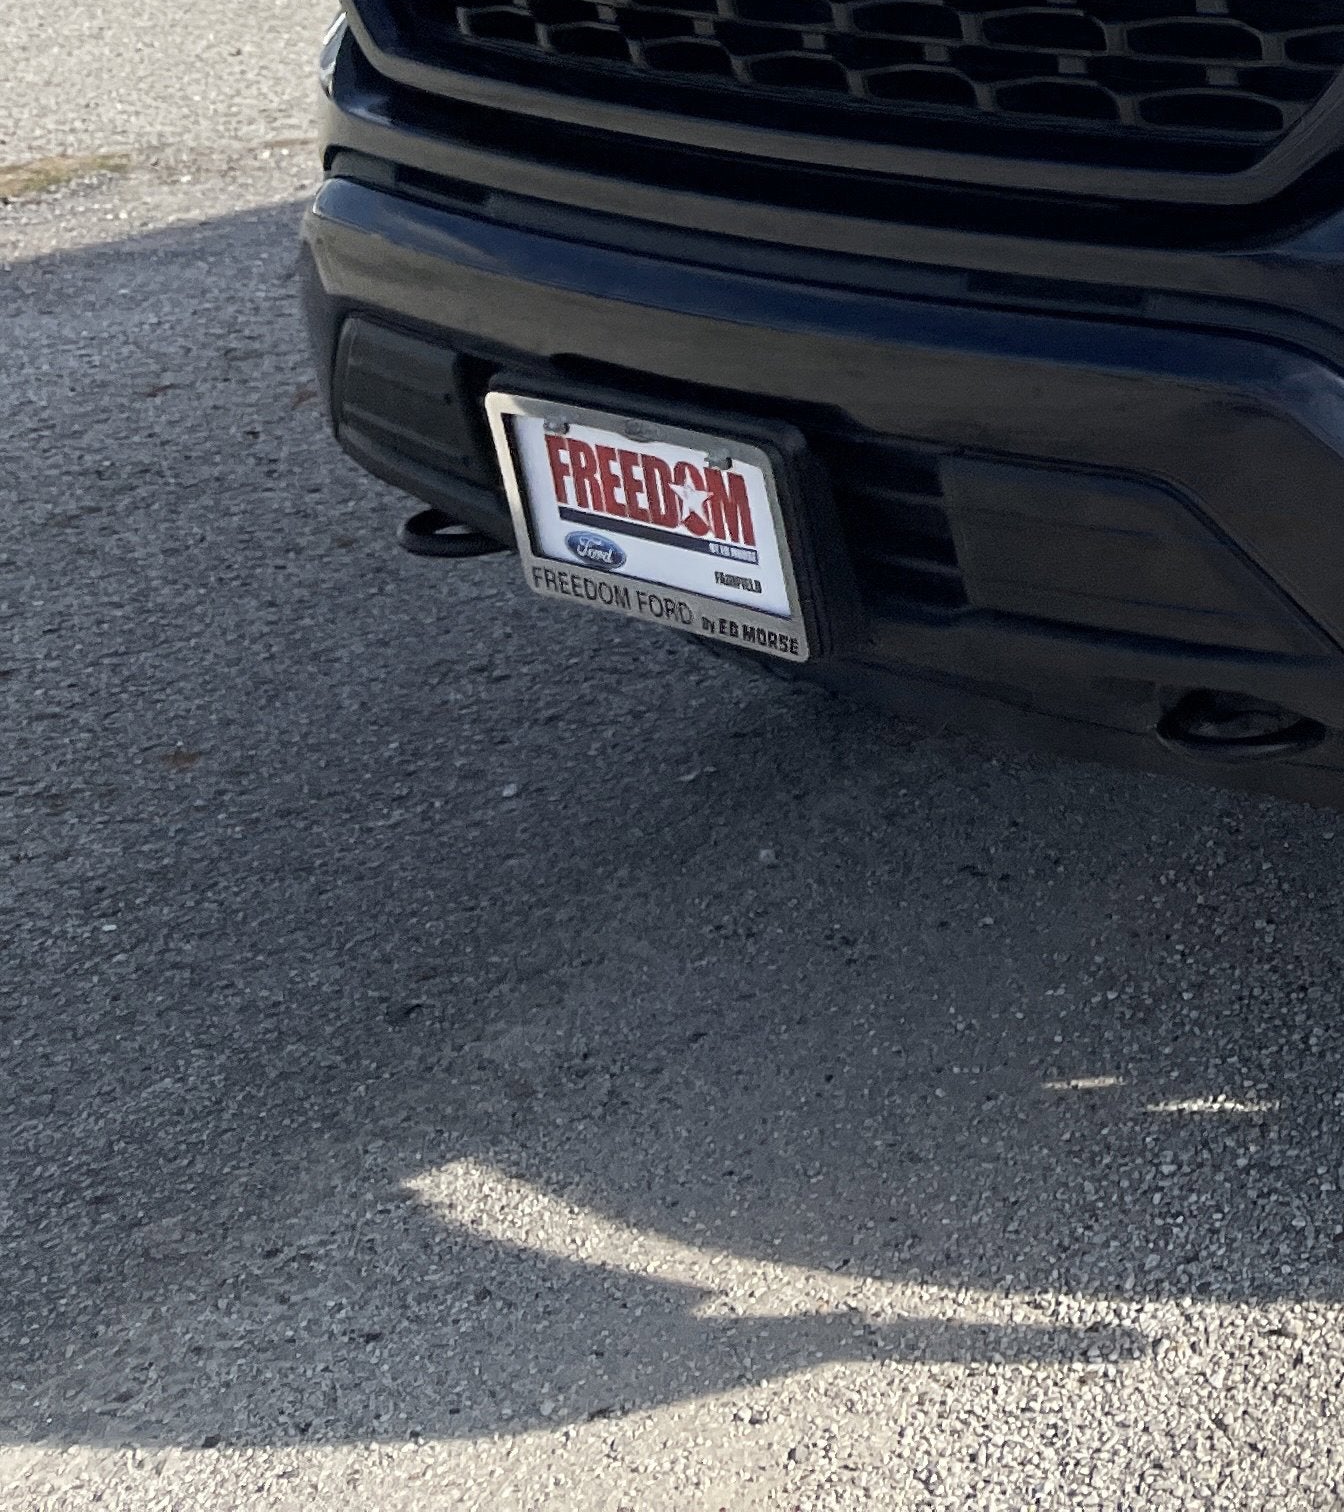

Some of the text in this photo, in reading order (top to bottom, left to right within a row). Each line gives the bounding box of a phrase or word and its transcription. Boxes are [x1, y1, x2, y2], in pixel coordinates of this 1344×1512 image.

[545, 434, 756, 546] FREEDOM
[576, 536, 613, 564] Ford
[531, 565, 632, 611] FREEDOM
[635, 589, 694, 625] FORD
[718, 618, 739, 638] ED
[741, 624, 800, 656] MORSE
